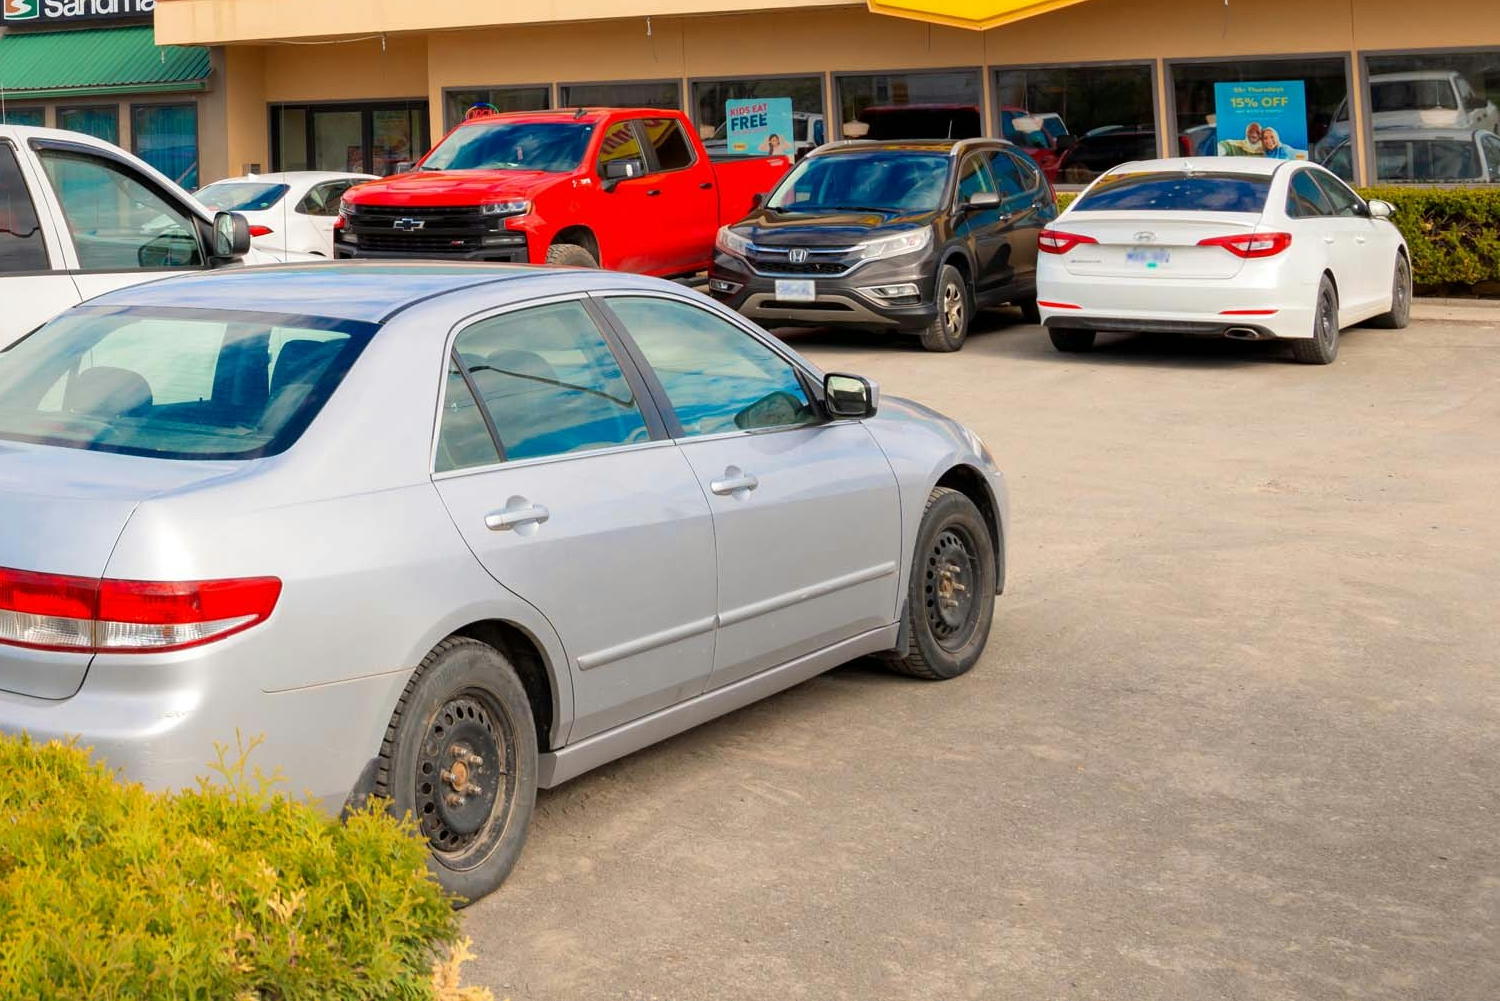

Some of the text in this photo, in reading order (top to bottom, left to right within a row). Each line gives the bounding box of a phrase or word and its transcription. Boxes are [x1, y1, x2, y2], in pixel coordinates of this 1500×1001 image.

[1230, 96, 1289, 108] 15% OFF
[730, 103, 767, 116] KIDS EAT
[731, 113, 768, 131] FREE
